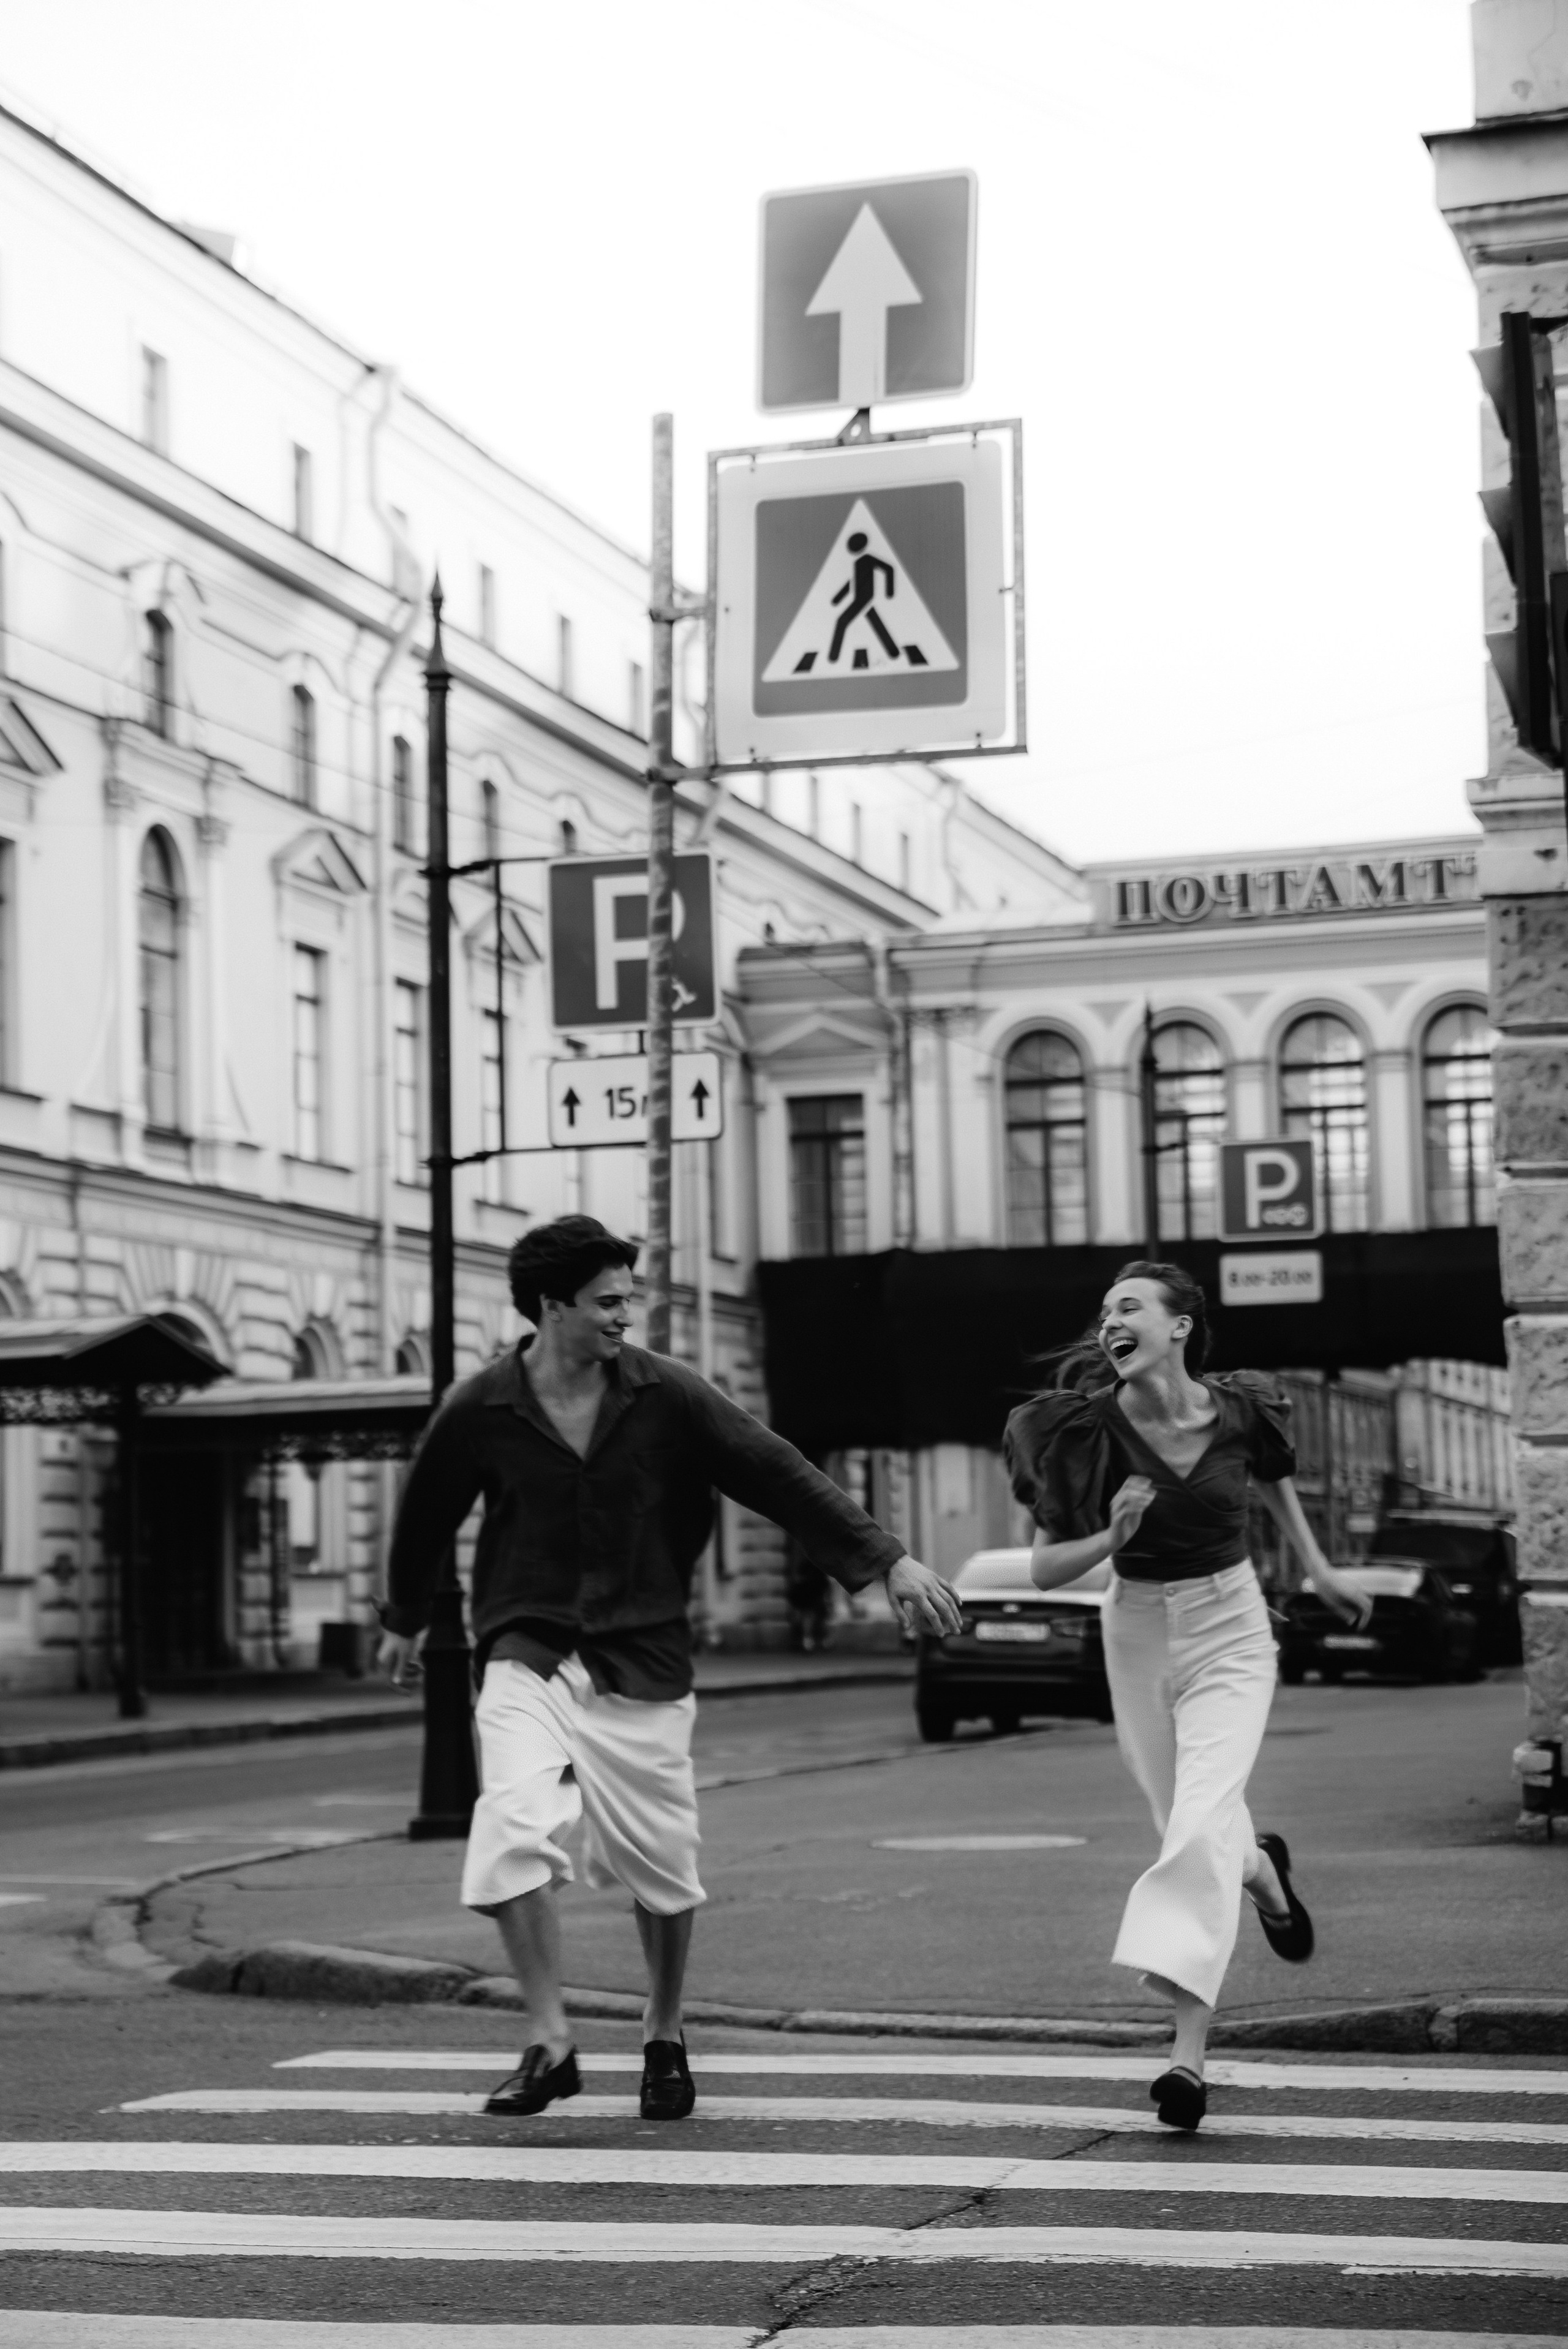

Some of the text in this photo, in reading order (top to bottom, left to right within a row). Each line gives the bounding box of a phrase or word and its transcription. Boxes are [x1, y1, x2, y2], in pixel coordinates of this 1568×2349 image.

[1111, 853, 1477, 926] ПОЧТАМТ
[605, 1087, 649, 1119] 15
[1244, 1148, 1300, 1229] P
